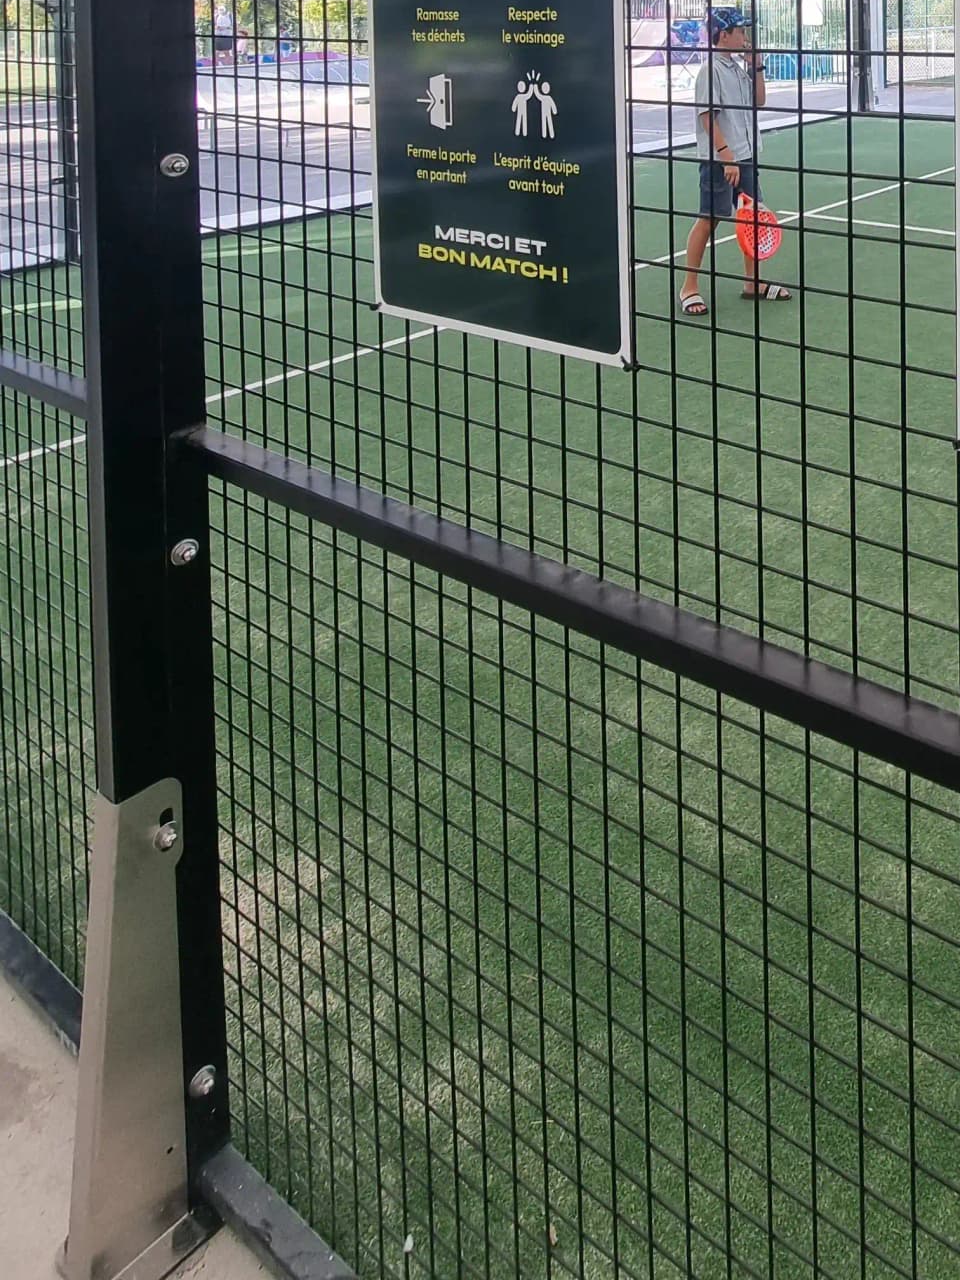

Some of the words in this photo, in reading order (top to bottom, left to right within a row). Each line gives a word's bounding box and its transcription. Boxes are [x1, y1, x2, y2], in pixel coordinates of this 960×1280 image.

[416, 7, 459, 21] Ramasse
[508, 7, 557, 24] Respecte
[412, 29, 426, 42] tes
[427, 28, 465, 43] déchets
[502, 29, 512, 44] le
[513, 29, 565, 47] voisinage
[407, 144, 437, 159] Ferme
[438, 147, 448, 161] la
[449, 150, 477, 164] porte
[494, 152, 531, 171] L'esprit
[533, 156, 580, 176] d'équipe
[416, 169, 428, 179] en
[430, 170, 467, 184] partant
[508, 178, 541, 193] avant
[541, 180, 565, 196] tout
[435, 225, 510, 251] MERCI
[515, 238, 547, 256] ET
[418, 243, 465, 265] BON
[470, 253, 557, 281] MATCH
